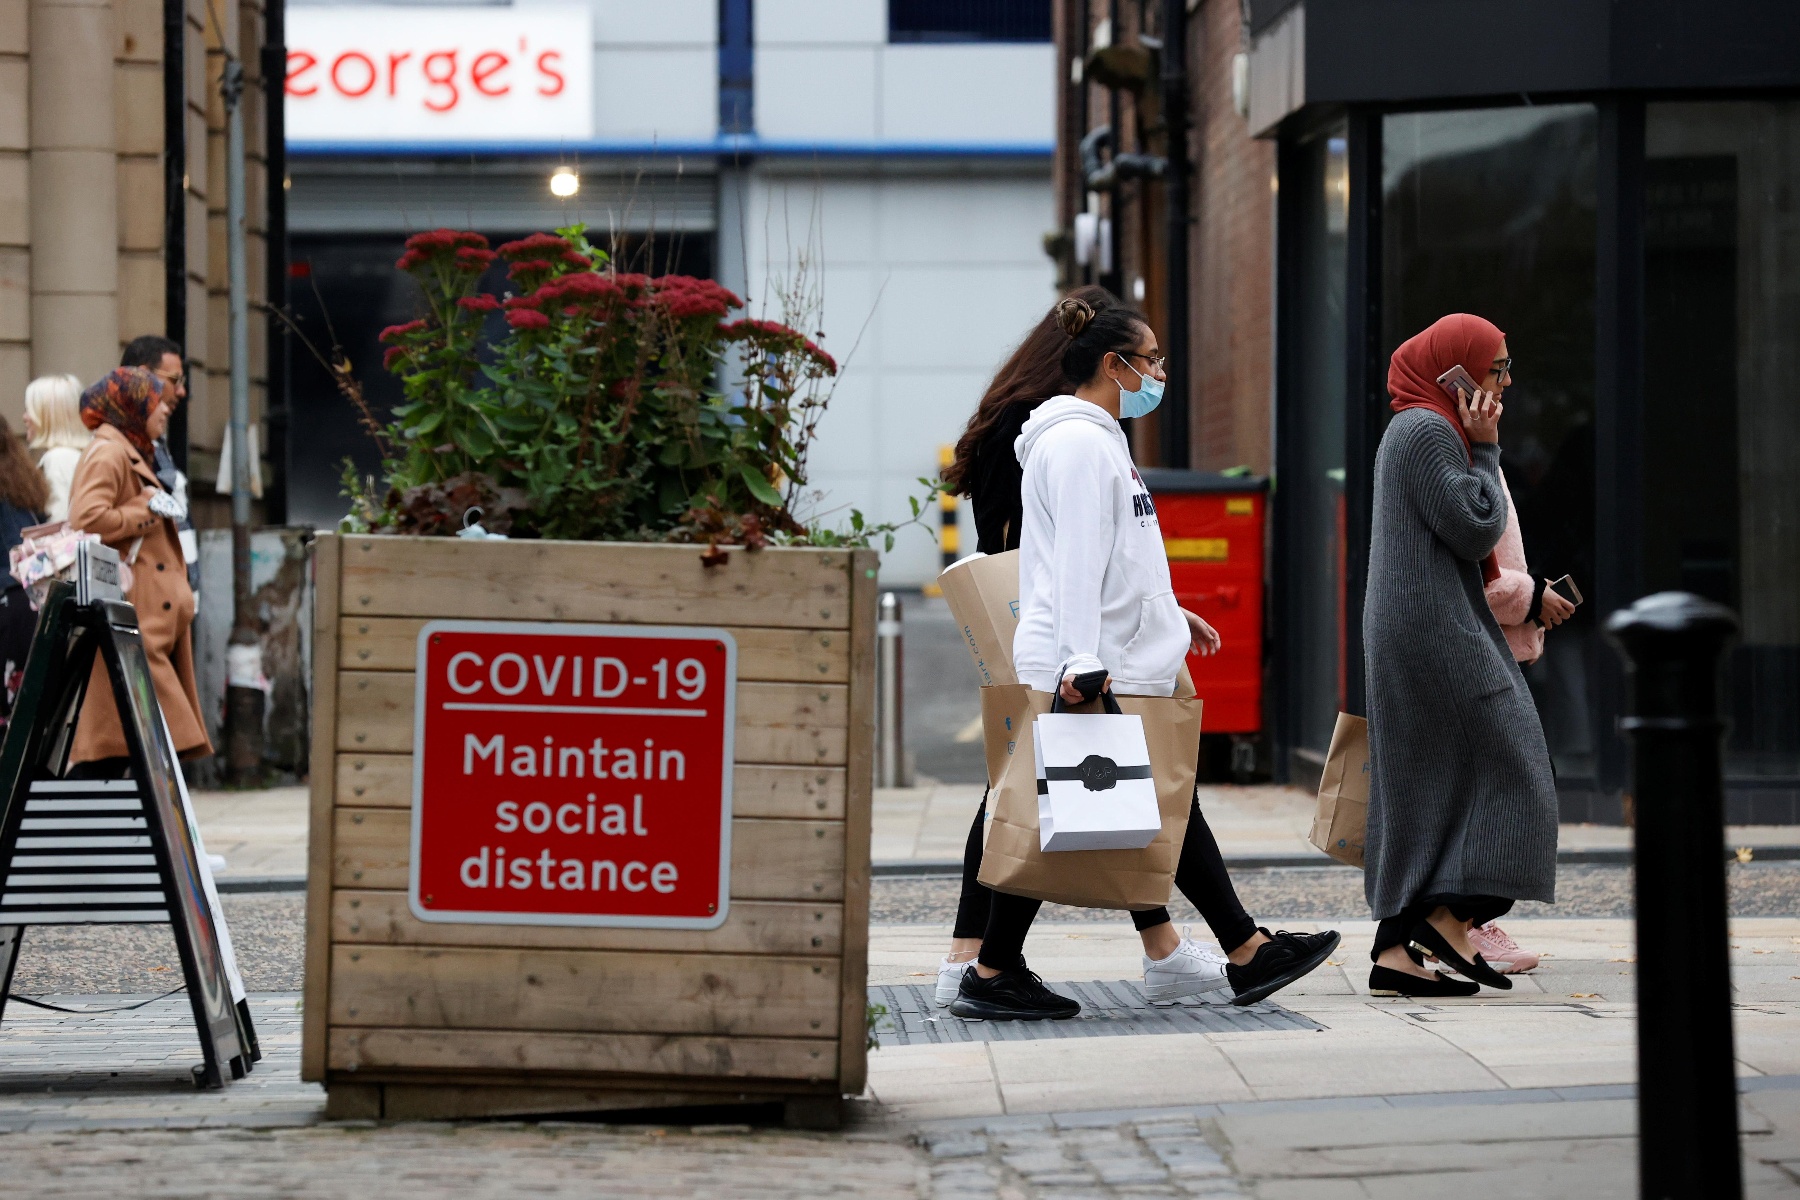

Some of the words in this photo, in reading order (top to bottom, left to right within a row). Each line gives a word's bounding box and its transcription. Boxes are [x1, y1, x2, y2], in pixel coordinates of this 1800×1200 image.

[284, 35, 565, 113] eorge's
[447, 651, 707, 700] COVID-19
[463, 733, 685, 780] Maintain
[495, 793, 648, 836] social
[460, 846, 678, 893] distance
